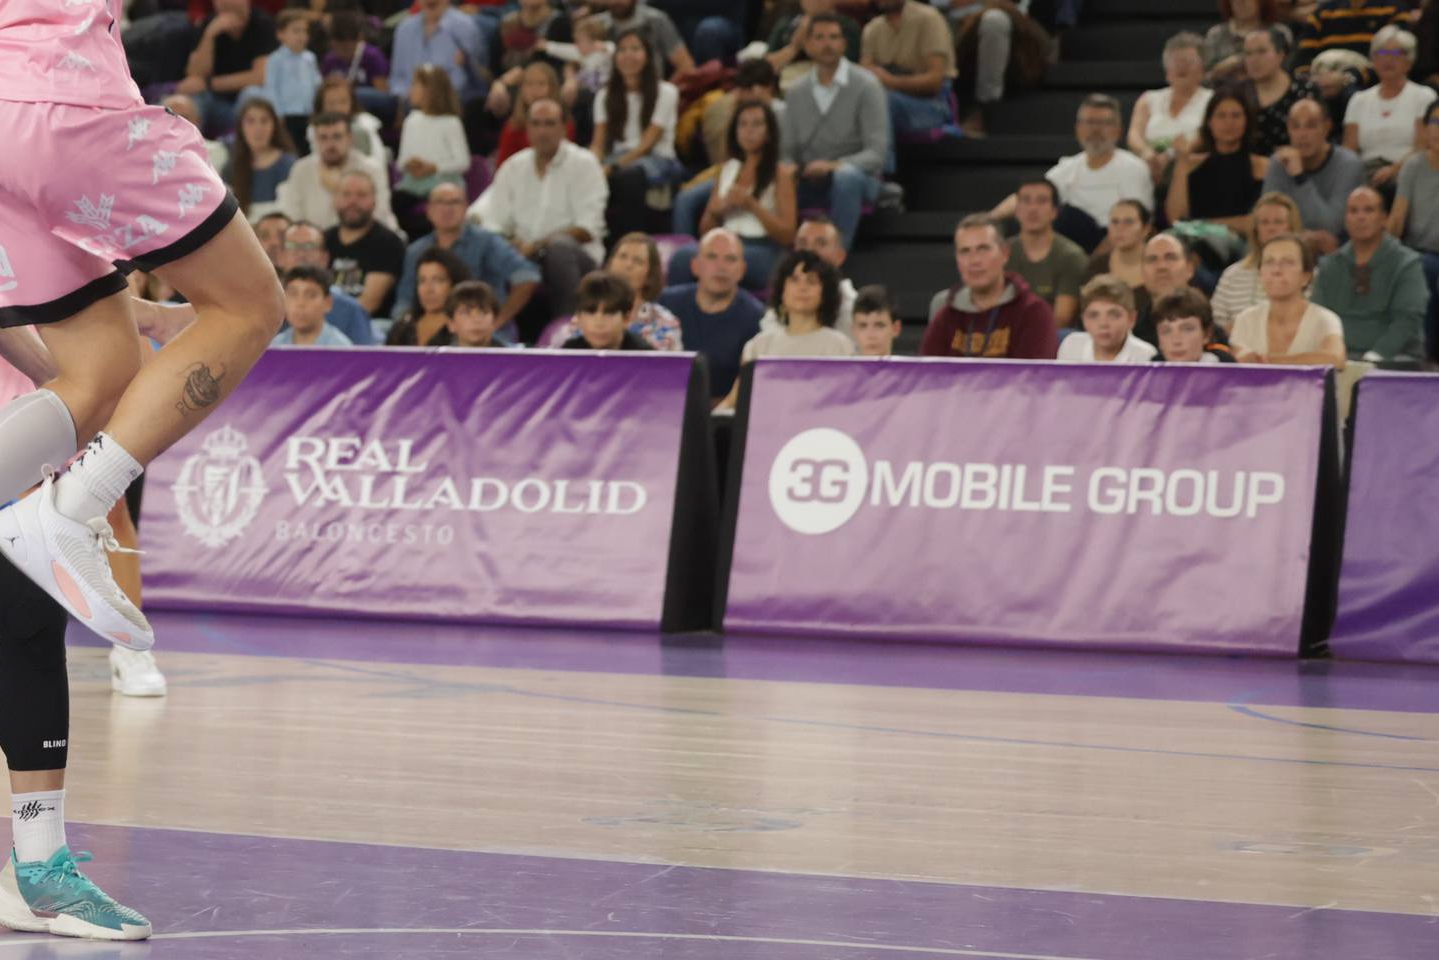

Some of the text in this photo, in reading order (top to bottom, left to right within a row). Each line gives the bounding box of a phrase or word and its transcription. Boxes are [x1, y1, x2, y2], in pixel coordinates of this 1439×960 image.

[284, 435, 427, 476] REAL
[285, 472, 648, 516] VALLADOLID
[869, 460, 1074, 512] MOBILE
[1087, 466, 1285, 518] GROUP
[275, 520, 455, 545] BALONCESTO
